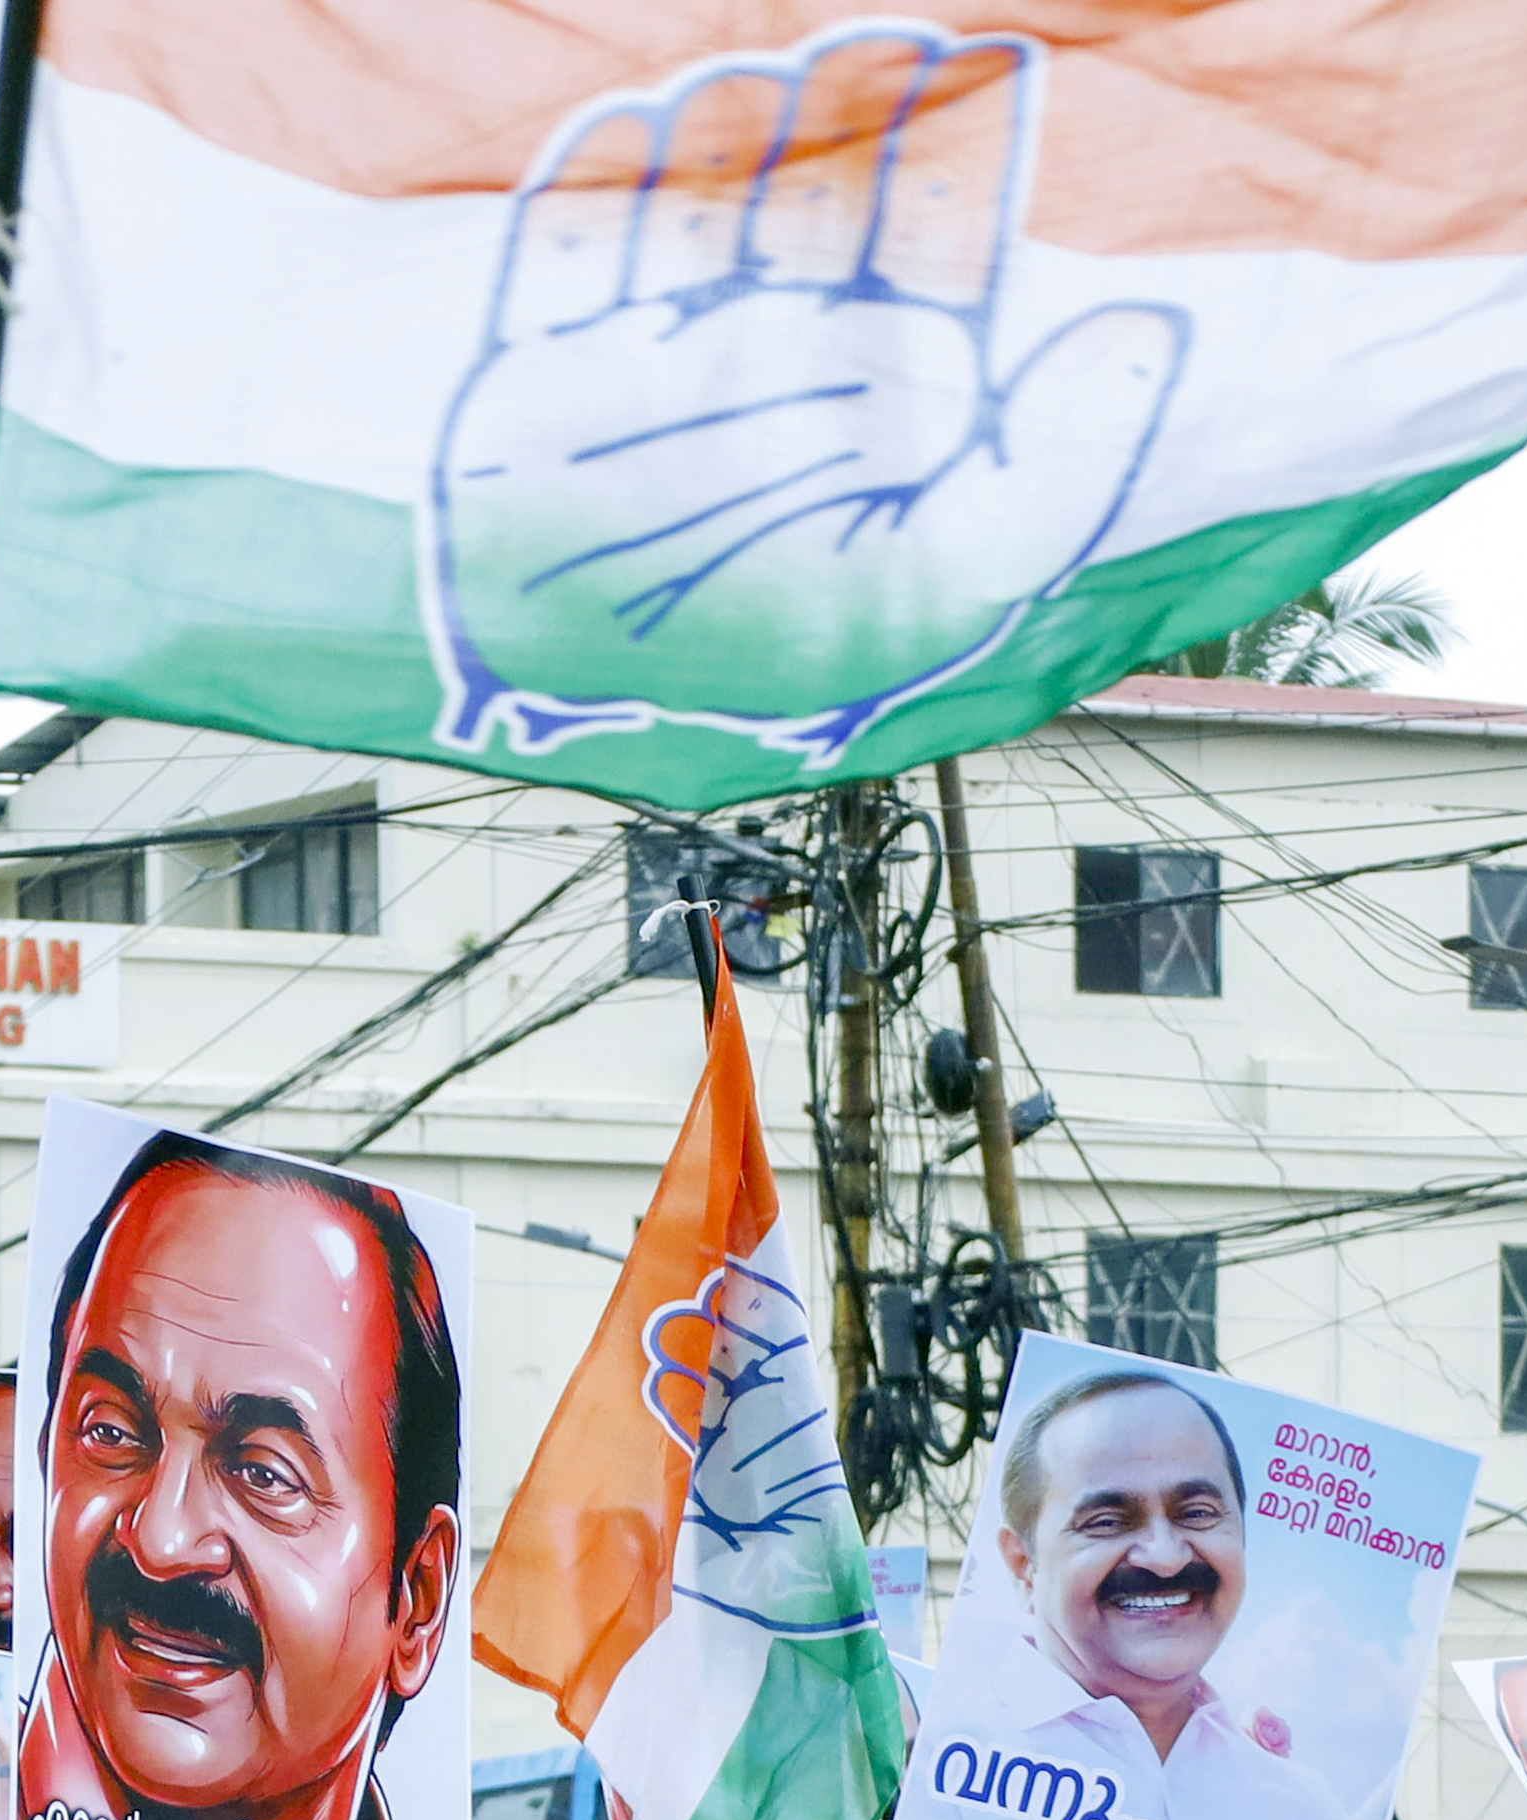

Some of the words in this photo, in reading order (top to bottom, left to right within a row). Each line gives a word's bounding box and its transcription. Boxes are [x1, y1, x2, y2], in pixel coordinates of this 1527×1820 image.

[1275, 1421, 1378, 1478] മാറാൻ,
[1267, 1456, 1372, 1509] കേരളം
[1255, 1491, 1318, 1537] മാറ്റി
[1324, 1509, 1446, 1572] മറിക്കാൻ
